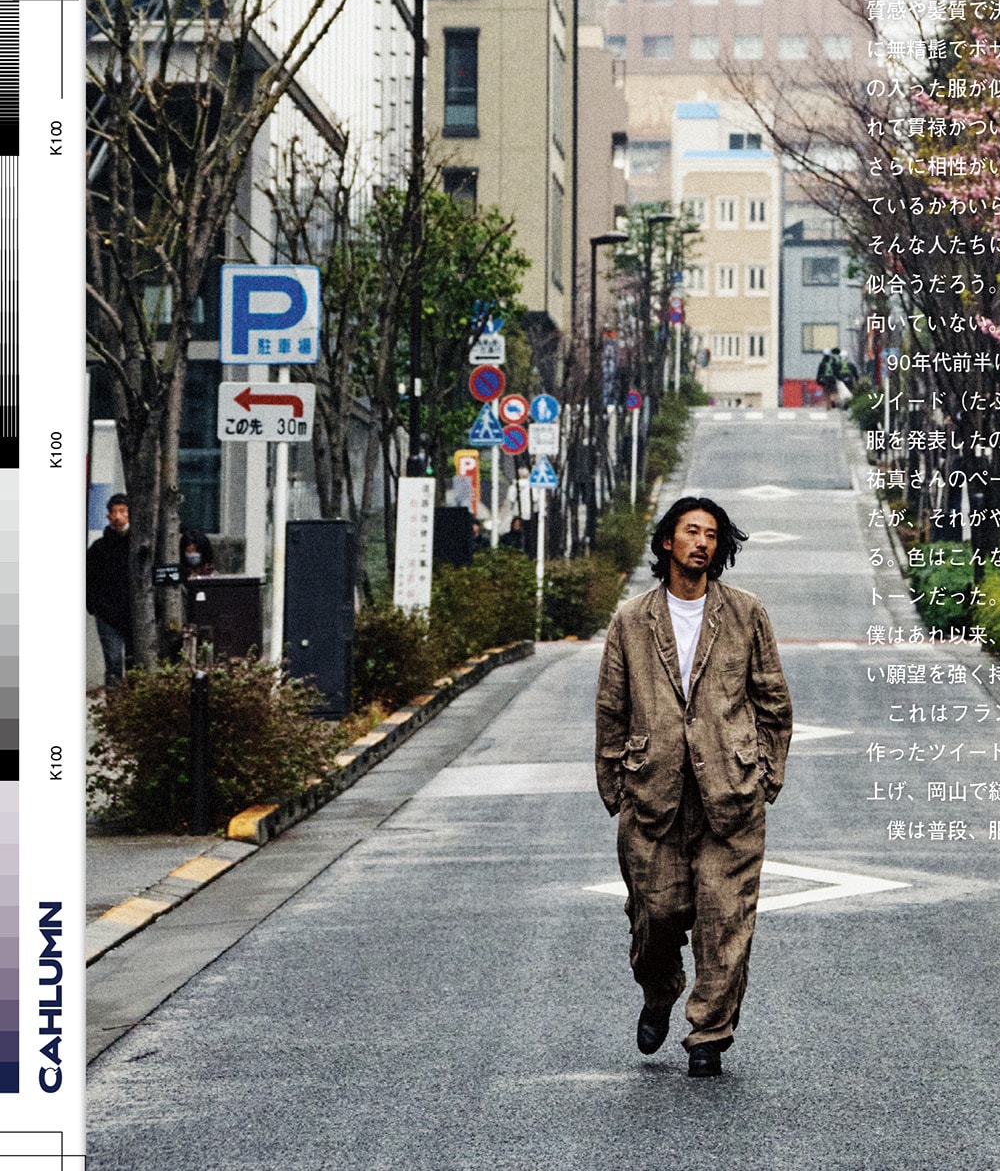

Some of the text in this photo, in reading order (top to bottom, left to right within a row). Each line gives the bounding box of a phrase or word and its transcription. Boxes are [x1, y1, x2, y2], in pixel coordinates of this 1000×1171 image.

[232, 275, 308, 355] P
[257, 337, 312, 355] 駐車場
[225, 418, 308, 436] この先 30m
[459, 457, 477, 476] P
